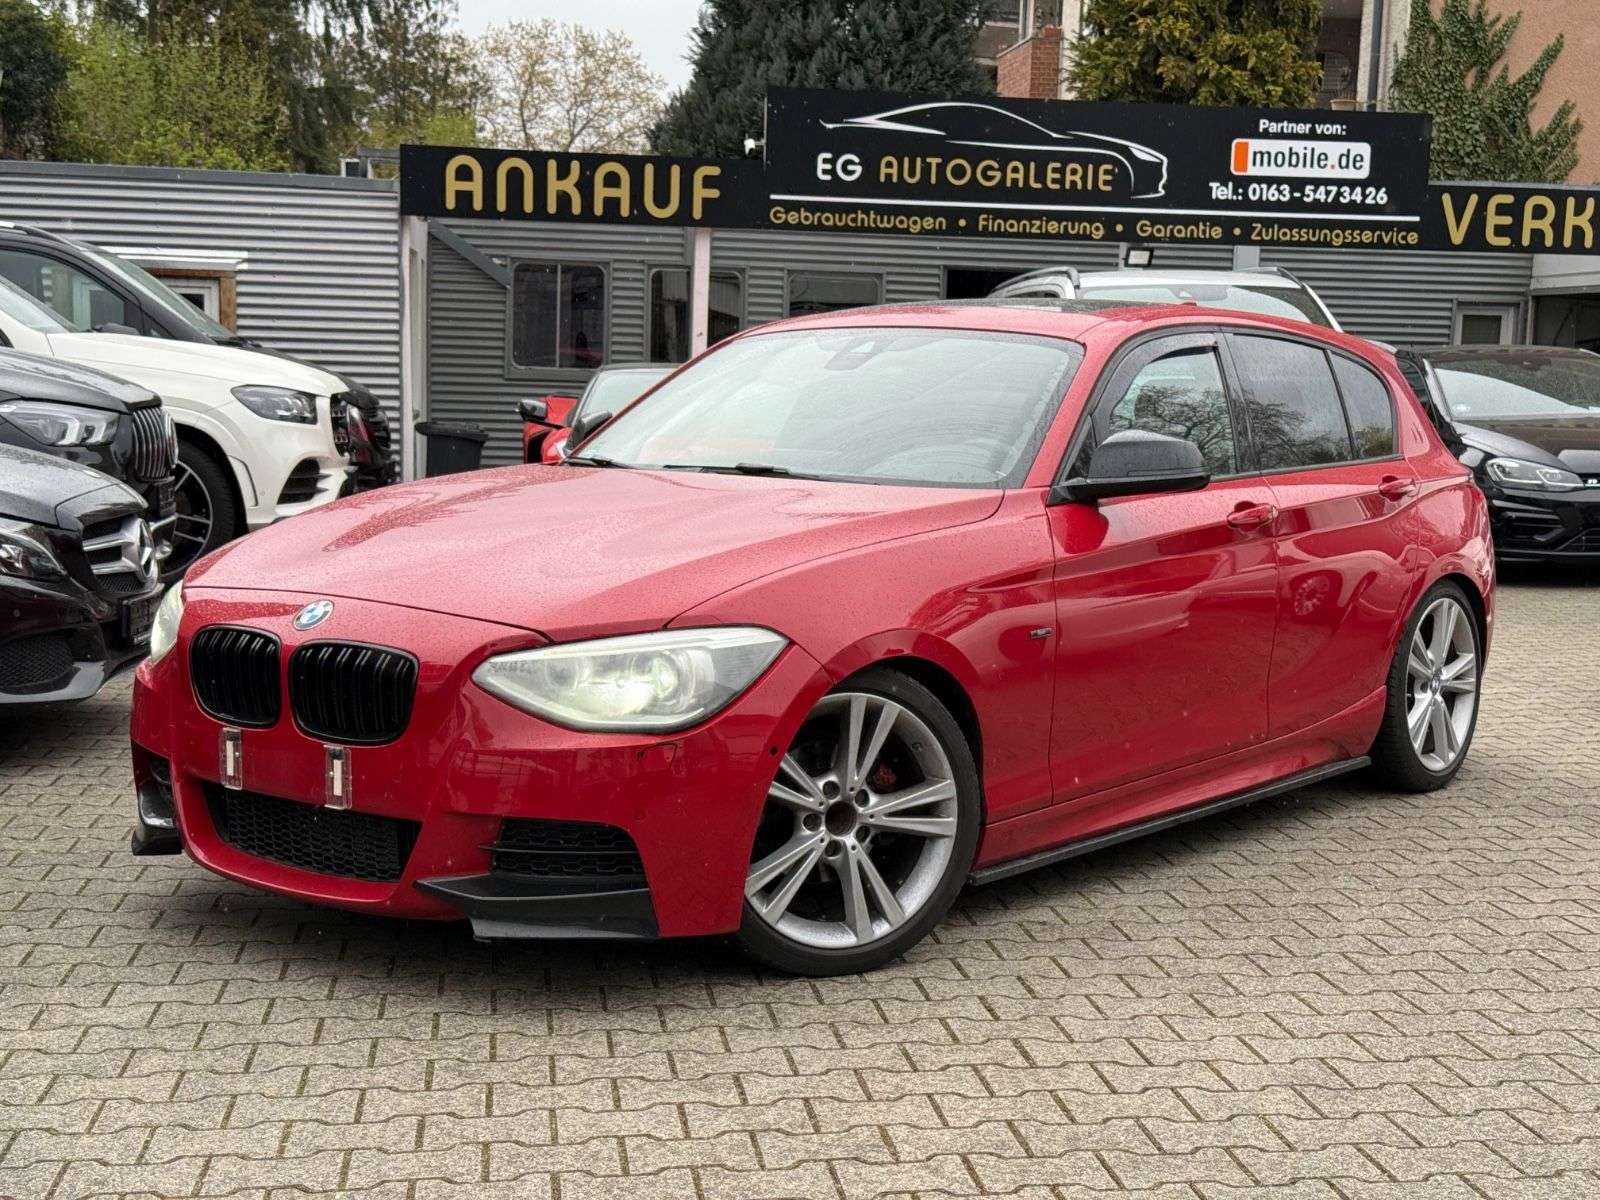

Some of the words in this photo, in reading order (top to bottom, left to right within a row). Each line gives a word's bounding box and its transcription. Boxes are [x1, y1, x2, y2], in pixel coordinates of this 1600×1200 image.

[1259, 119, 1312, 134] Partner
[1315, 123, 1347, 135] von:
[817, 153, 863, 182] EG
[879, 155, 1114, 191] AUTOGALERIE
[1252, 147, 1365, 170] mobile.de
[445, 154, 721, 220] ANKAUF
[1209, 182, 1243, 201] Tel.:
[769, 206, 947, 234] Gebrauchtwagen
[977, 214, 1105, 240] Finanzierung
[1135, 220, 1223, 241] Garantie
[1250, 222, 1420, 246] Zulassungsservice
[1441, 191, 1595, 249] VERK
